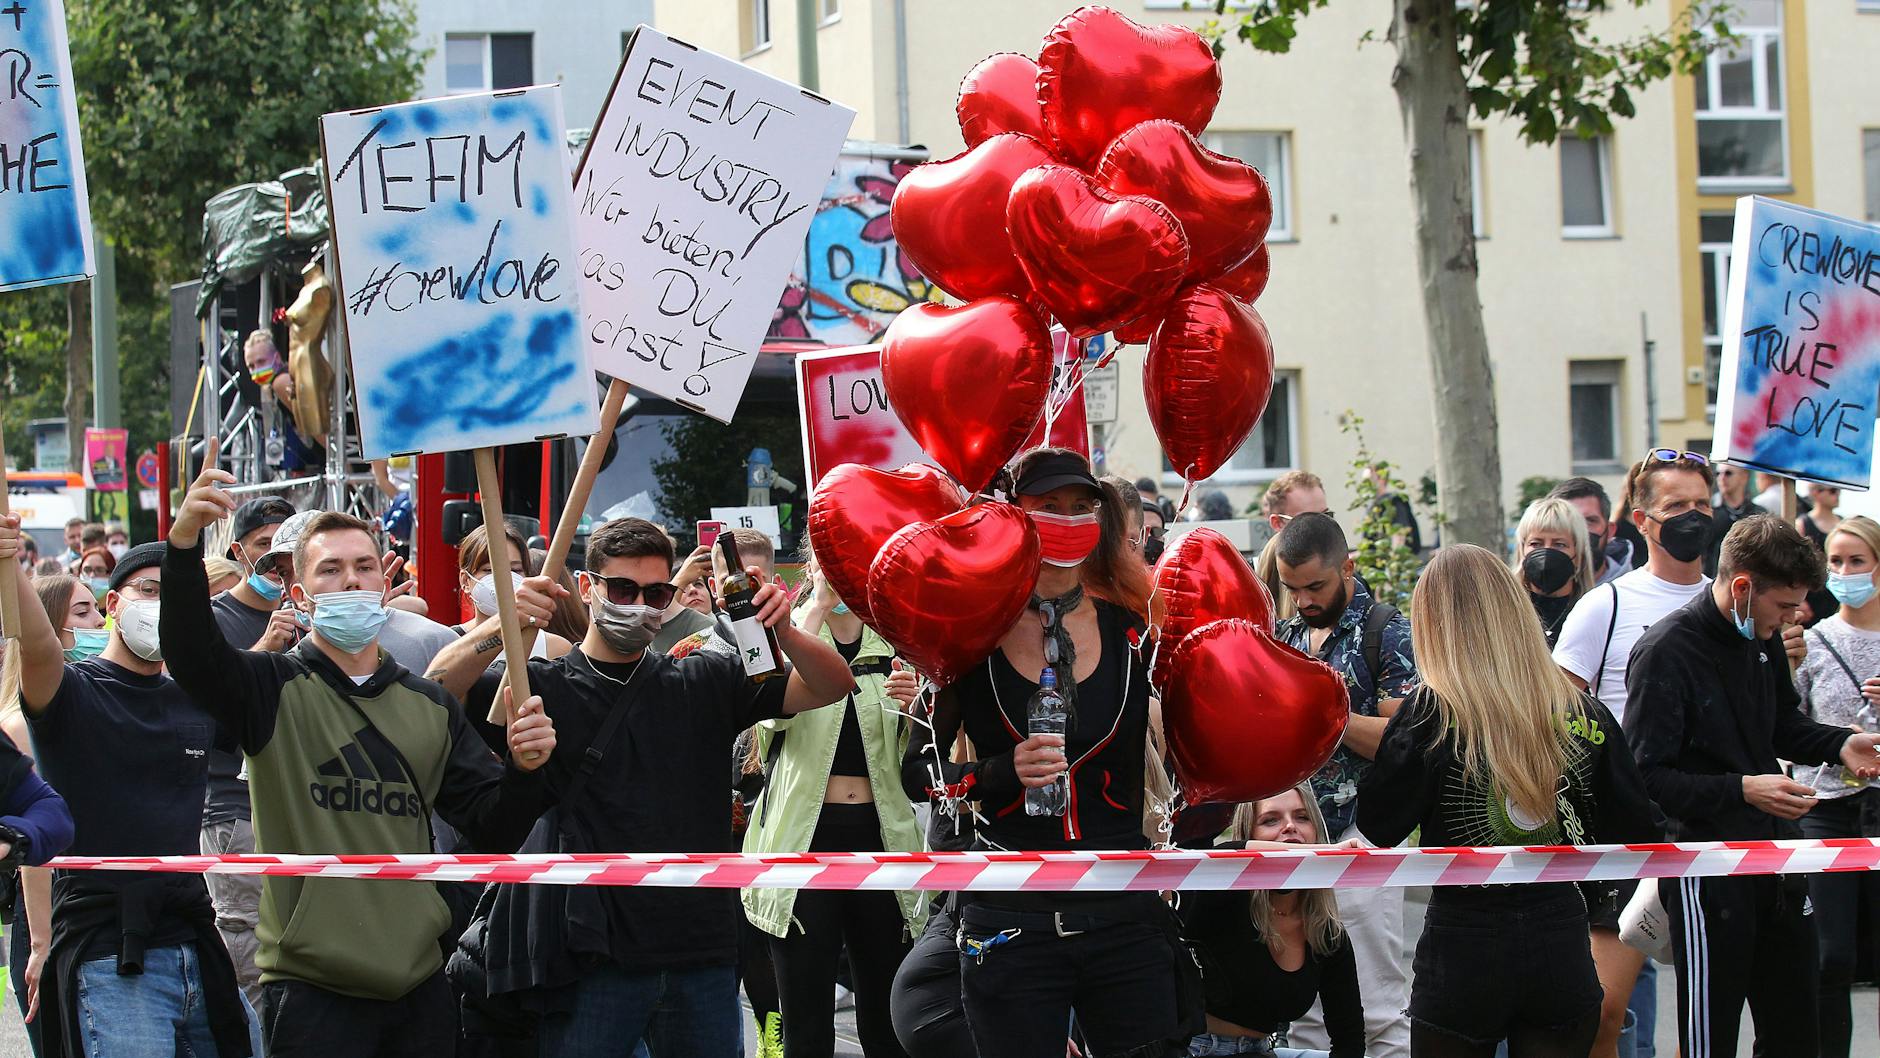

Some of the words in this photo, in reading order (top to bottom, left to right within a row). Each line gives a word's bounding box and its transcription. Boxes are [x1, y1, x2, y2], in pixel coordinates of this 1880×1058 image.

[0, 48, 60, 108] R=
[637, 57, 797, 141] EVENT
[0, 132, 71, 194] HE
[334, 118, 526, 214] TEAM
[580, 168, 631, 222] Wir
[614, 115, 809, 260] INDUSTRY
[1758, 222, 1880, 297] CREWLOVE
[580, 247, 625, 291] as
[652, 268, 733, 342] DU
[1784, 290, 1821, 331] IS
[1743, 323, 1838, 390] TRUE
[828, 375, 888, 420] LOV
[1765, 386, 1865, 455] LOVE
[738, 515, 753, 528] 15
[310, 778, 419, 819] adidas
